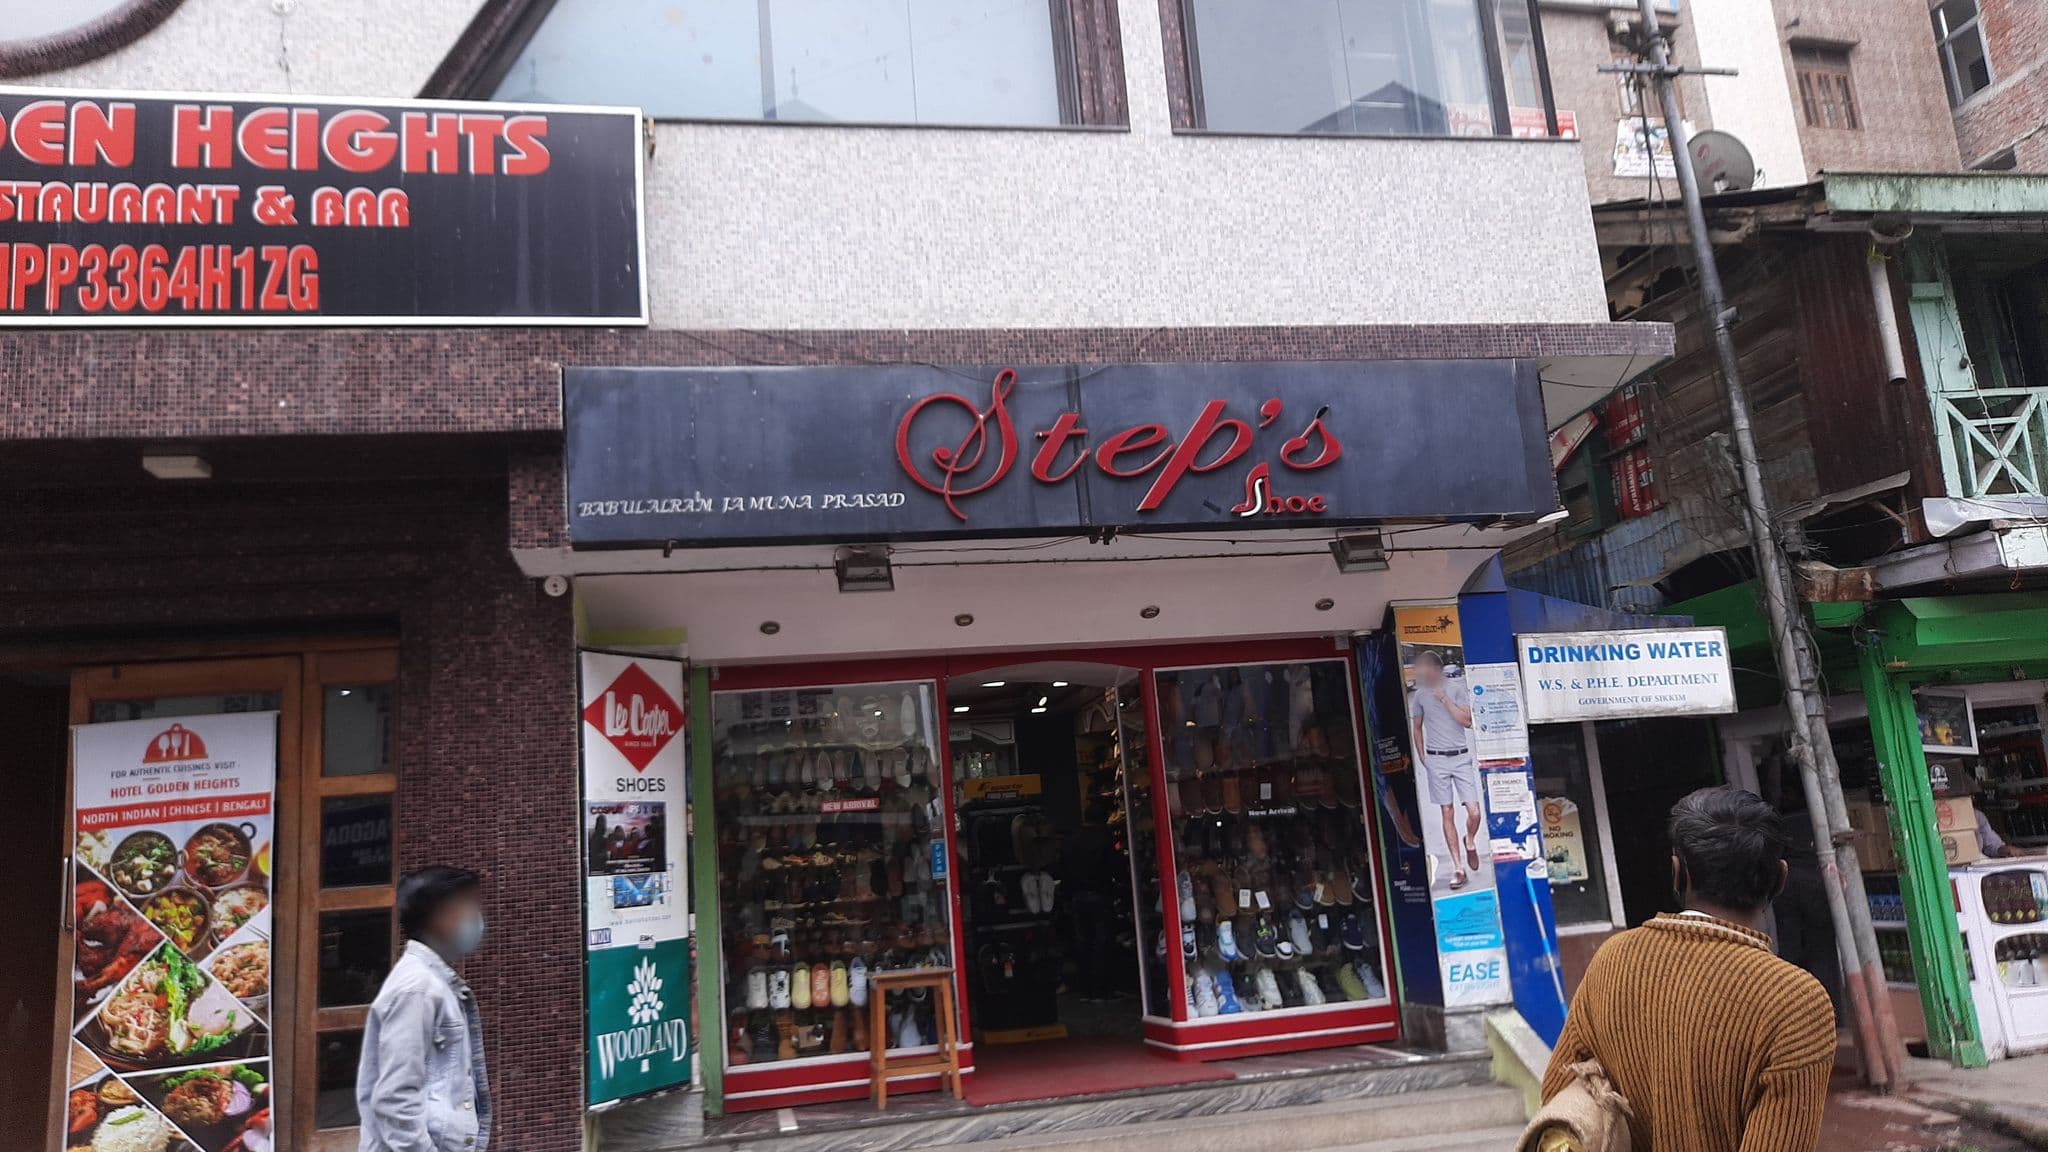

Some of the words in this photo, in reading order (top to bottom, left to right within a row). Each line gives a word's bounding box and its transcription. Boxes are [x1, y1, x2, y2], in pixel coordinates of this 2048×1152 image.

[0, 100, 136, 168] EN
[171, 104, 552, 177] HEIGHTS
[252, 184, 299, 226] &
[311, 186, 411, 228] BAR
[896, 367, 1343, 520] Step's
[820, 492, 906, 509] PRASAD
[1230, 462, 1328, 518] Shoe
[1528, 643, 1641, 664] DRINKING
[1647, 641, 1722, 660] WATER
[1538, 678, 1567, 691] W.S.
[1571, 678, 1583, 690] &
[1587, 676, 1624, 689] P.H.E.
[1627, 672, 1720, 688] DEPARTMENT
[1578, 695, 1639, 706] GOVERNMENT
[1641, 695, 1652, 703] OF
[1655, 693, 1687, 703] SIKKIM
[604, 690, 630, 737] Lee
[631, 693, 676, 747] Cooper
[111, 769, 127, 779] FOR
[129, 766, 171, 778] AUTHENTIC
[173, 763, 211, 773] CUISINES
[214, 761, 236, 770] VISIT
[110, 785, 142, 799] HOTEL
[147, 781, 190, 795] GOLDEN
[193, 777, 241, 791] HEIGHTS
[616, 777, 666, 793] SHOES
[82, 812, 119, 825] NORTH
[122, 808, 160, 821] INDIAN
[169, 802, 212, 816] CHINESE
[222, 799, 266, 812] BENGALI
[823, 801, 841, 812] NEW
[843, 799, 879, 810] ARRIVAL
[1543, 830, 1574, 839] MOKING
[1549, 825, 1562, 833] NO
[1449, 960, 1501, 983] EASE
[597, 1017, 688, 1081] WOODLAND
